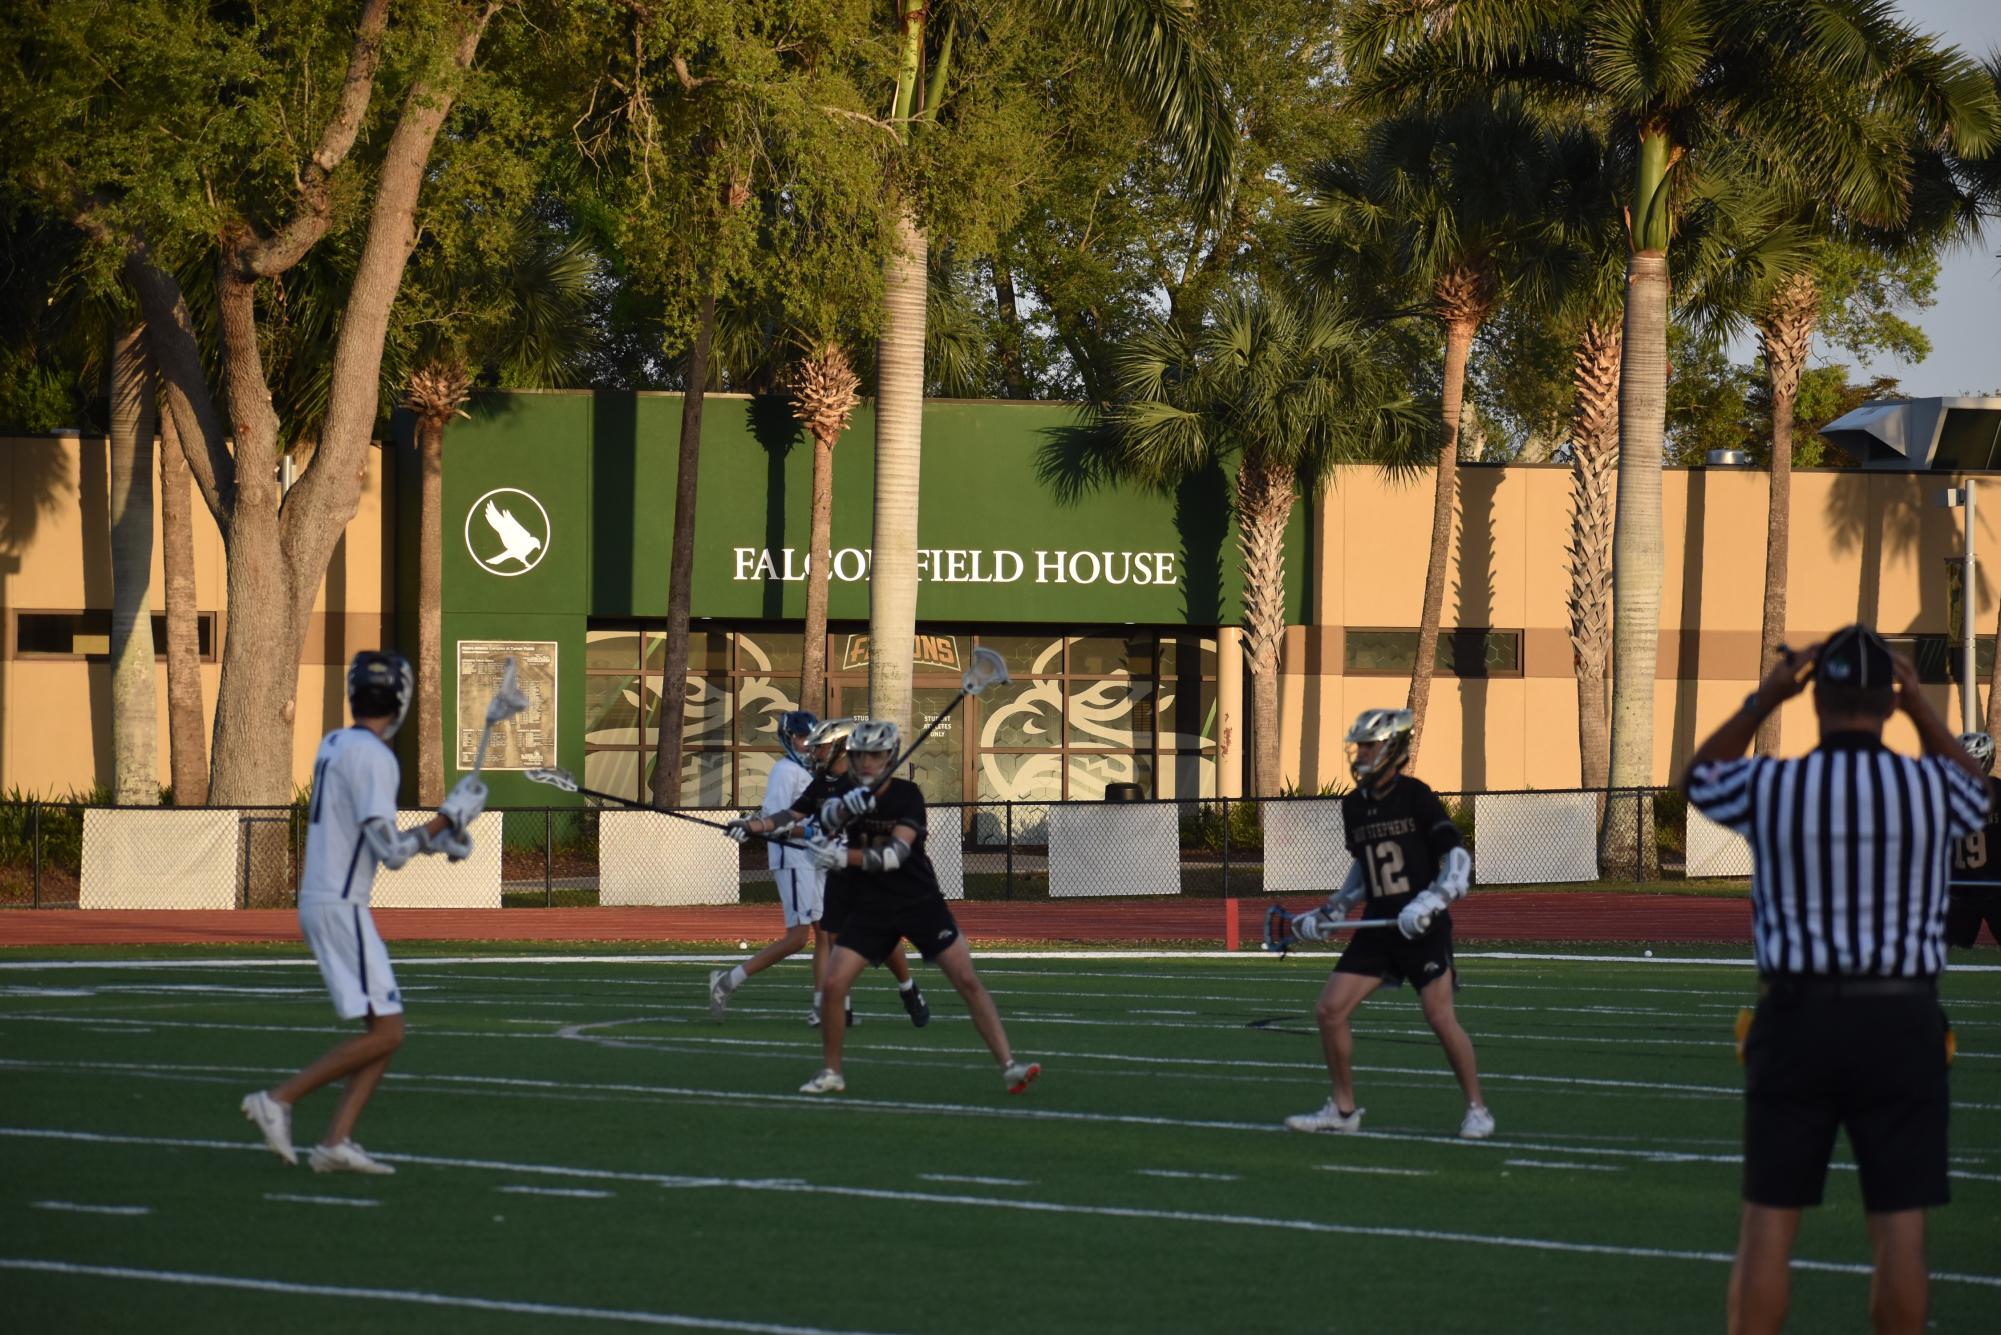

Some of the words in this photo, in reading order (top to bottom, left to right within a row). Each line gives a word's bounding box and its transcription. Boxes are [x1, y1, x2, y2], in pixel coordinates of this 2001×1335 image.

[733, 547, 872, 583] FALO
[1035, 551, 1177, 585] HOUSE
[1365, 841, 1410, 898] 12
[1954, 830, 1988, 870] 19
